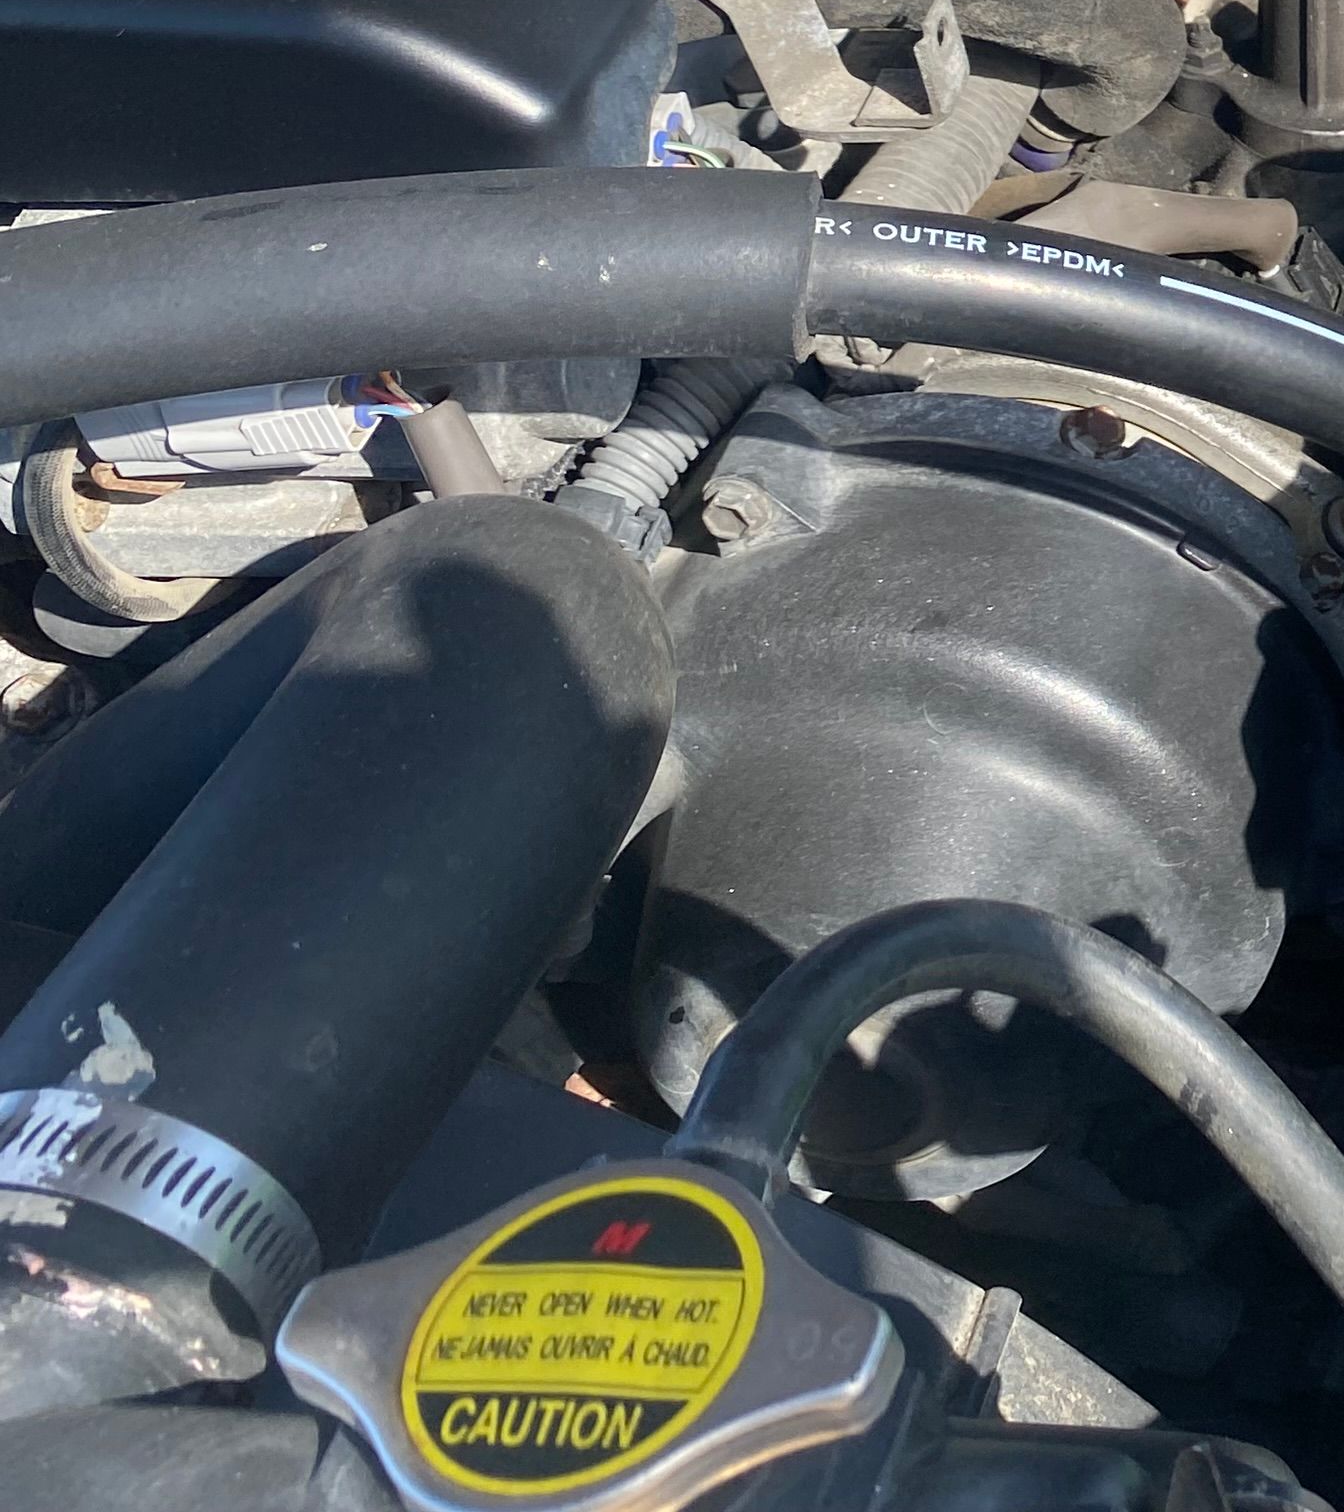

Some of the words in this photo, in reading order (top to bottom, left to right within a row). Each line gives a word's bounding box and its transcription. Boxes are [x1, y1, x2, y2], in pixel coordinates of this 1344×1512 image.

[872, 223, 987, 253] OUTER
[464, 1291, 527, 1318] NEVER
[539, 1291, 593, 1318] OPEN
[605, 1292, 664, 1321] WHEN
[675, 1299, 721, 1324] HOT.
[540, 1336, 614, 1361] OUVRIR
[644, 1340, 710, 1368] CHAUD.
[440, 1397, 643, 1450] CAUTION
